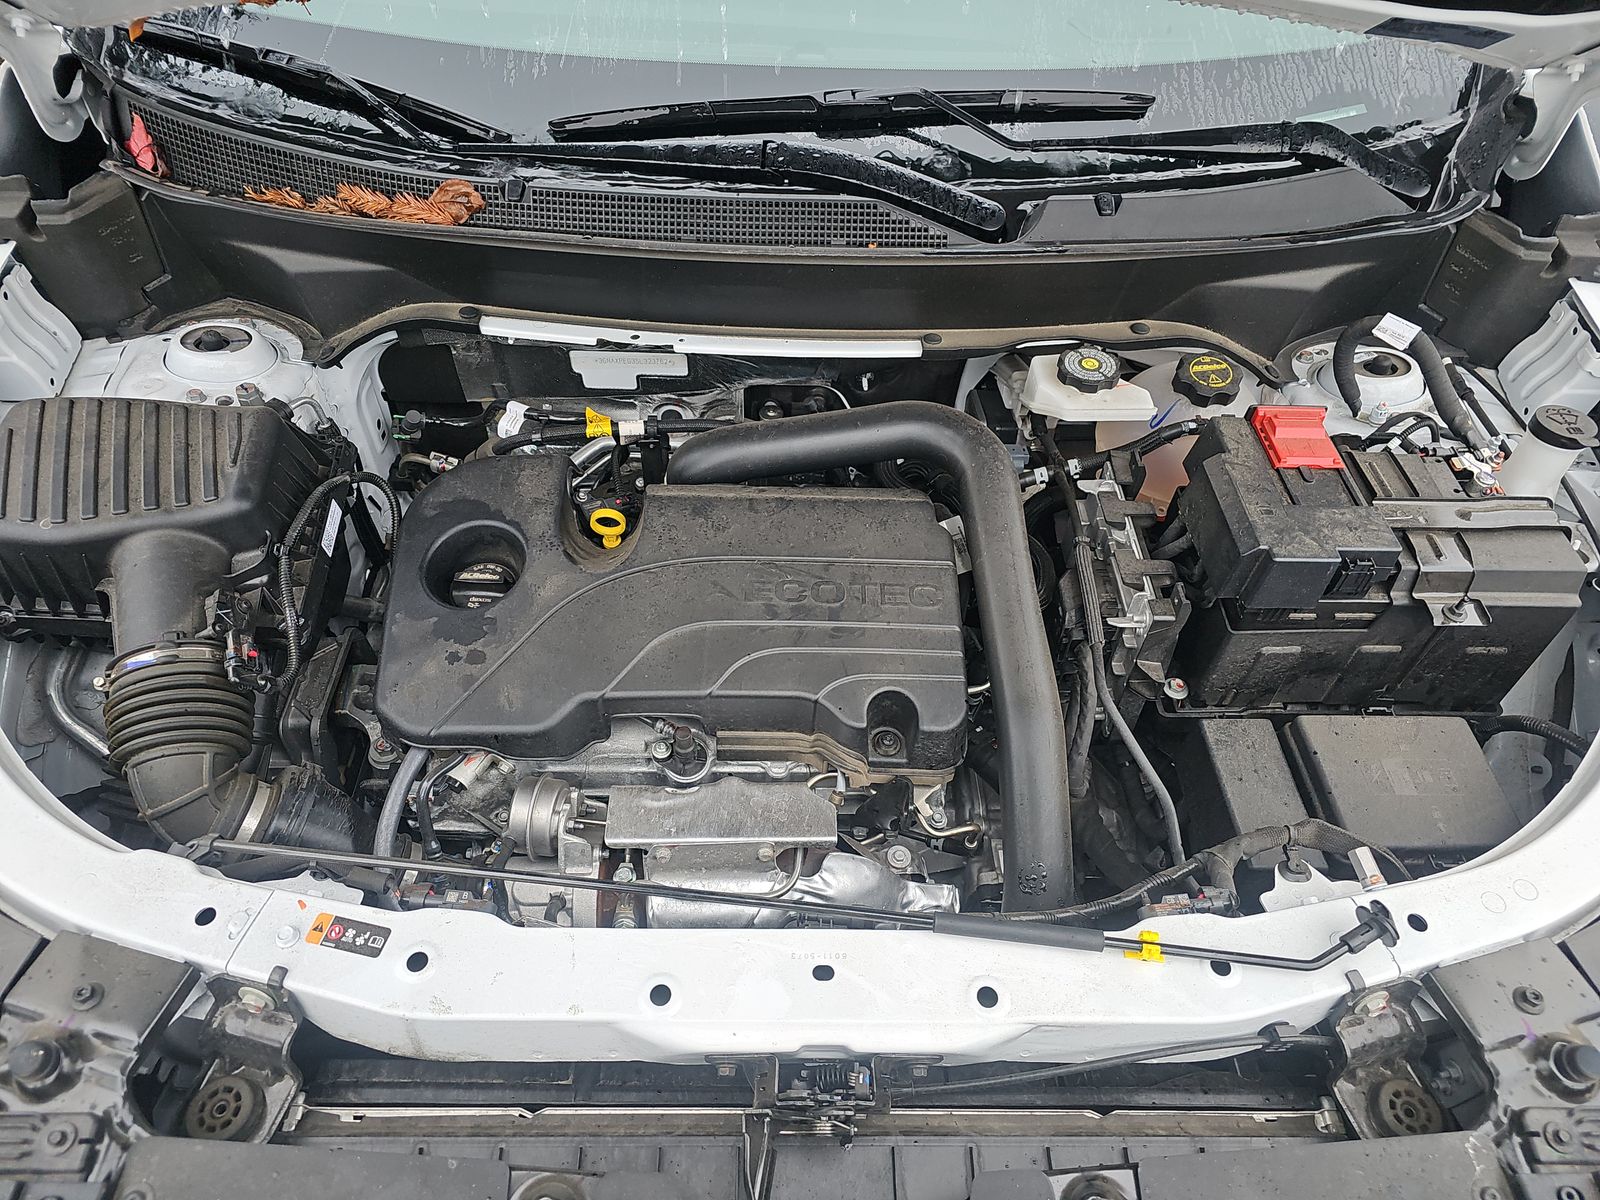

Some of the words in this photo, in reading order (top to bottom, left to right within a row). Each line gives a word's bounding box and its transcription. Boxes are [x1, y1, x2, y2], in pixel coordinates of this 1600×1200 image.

[458, 572, 500, 580] ACDelco
[744, 579, 943, 608] ECOTEC
[462, 891, 469, 900] B
